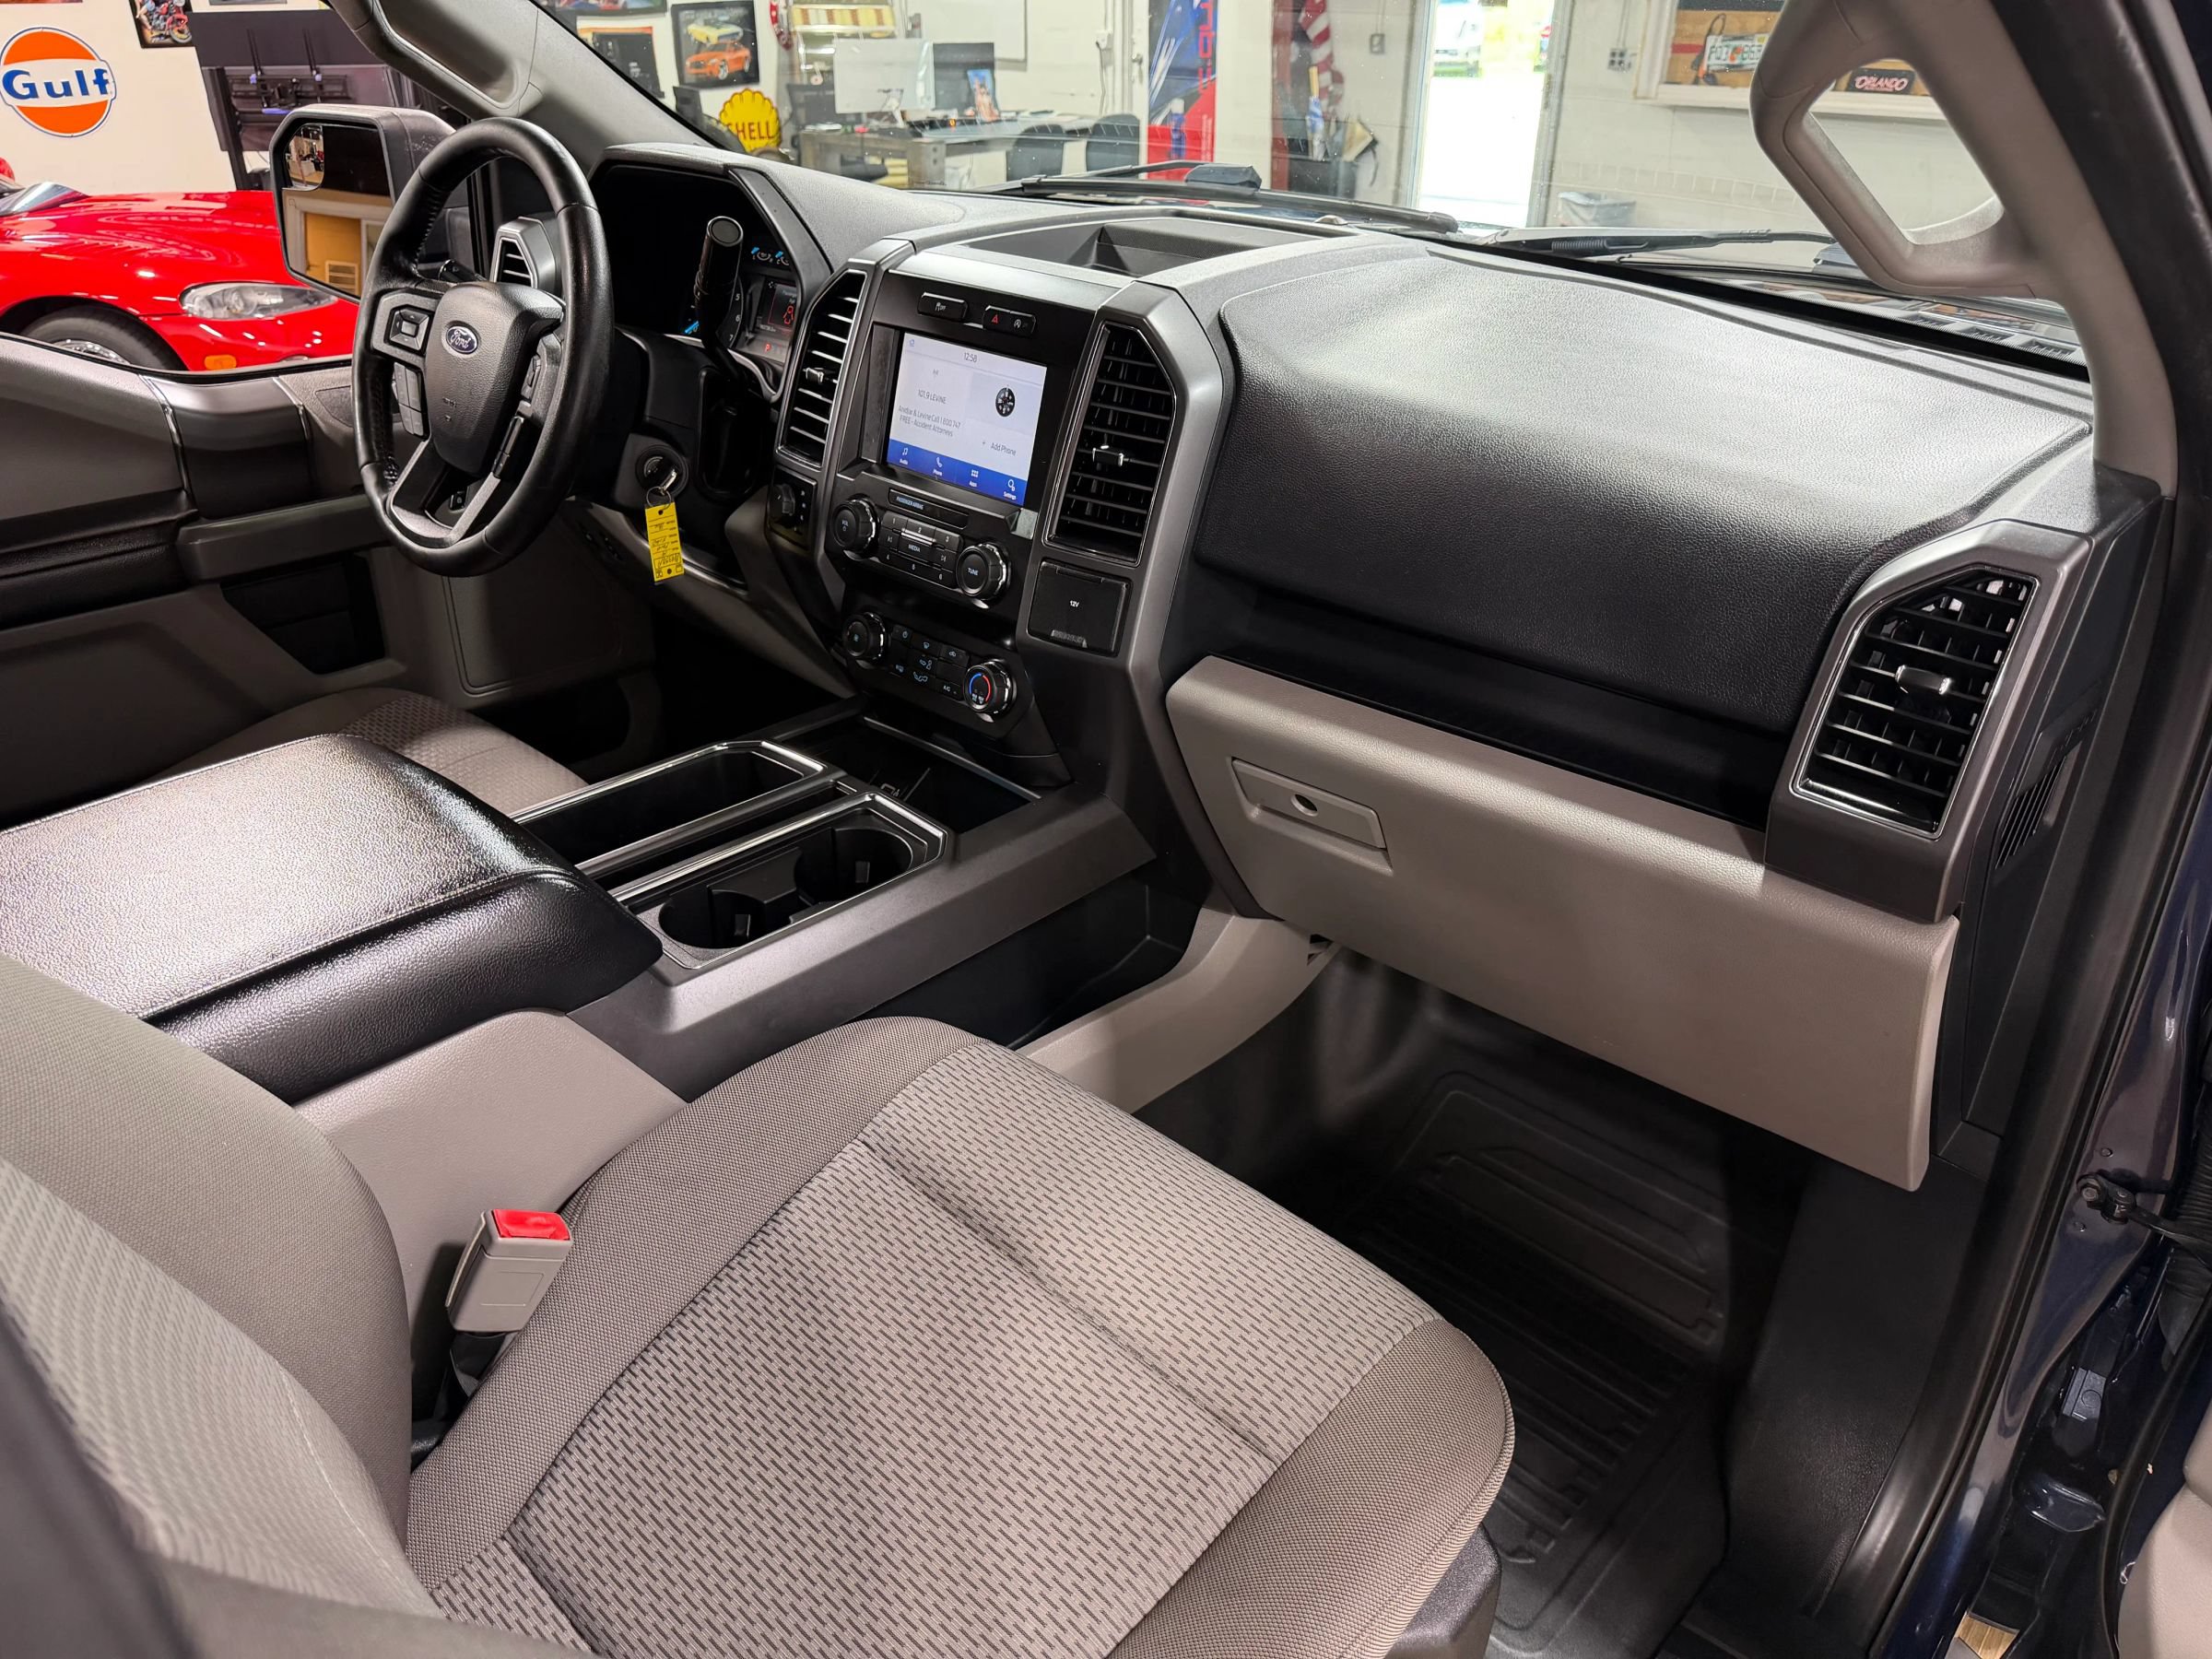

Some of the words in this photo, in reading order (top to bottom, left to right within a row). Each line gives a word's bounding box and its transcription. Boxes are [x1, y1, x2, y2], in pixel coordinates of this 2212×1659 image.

[2, 68, 110, 100] Gulf
[1854, 75, 1909, 91] ORLANDO
[726, 122, 775, 140] HELL
[450, 328, 472, 349] Ford
[963, 352, 978, 363] 12:58
[930, 393, 947, 405] LEVINE
[991, 442, 1001, 452] Add
[1001, 444, 1017, 456] Phone
[892, 517, 896, 525] 1
[945, 535, 949, 544] 3
[908, 543, 921, 553] MEDIA
[967, 567, 980, 577] TUNE
